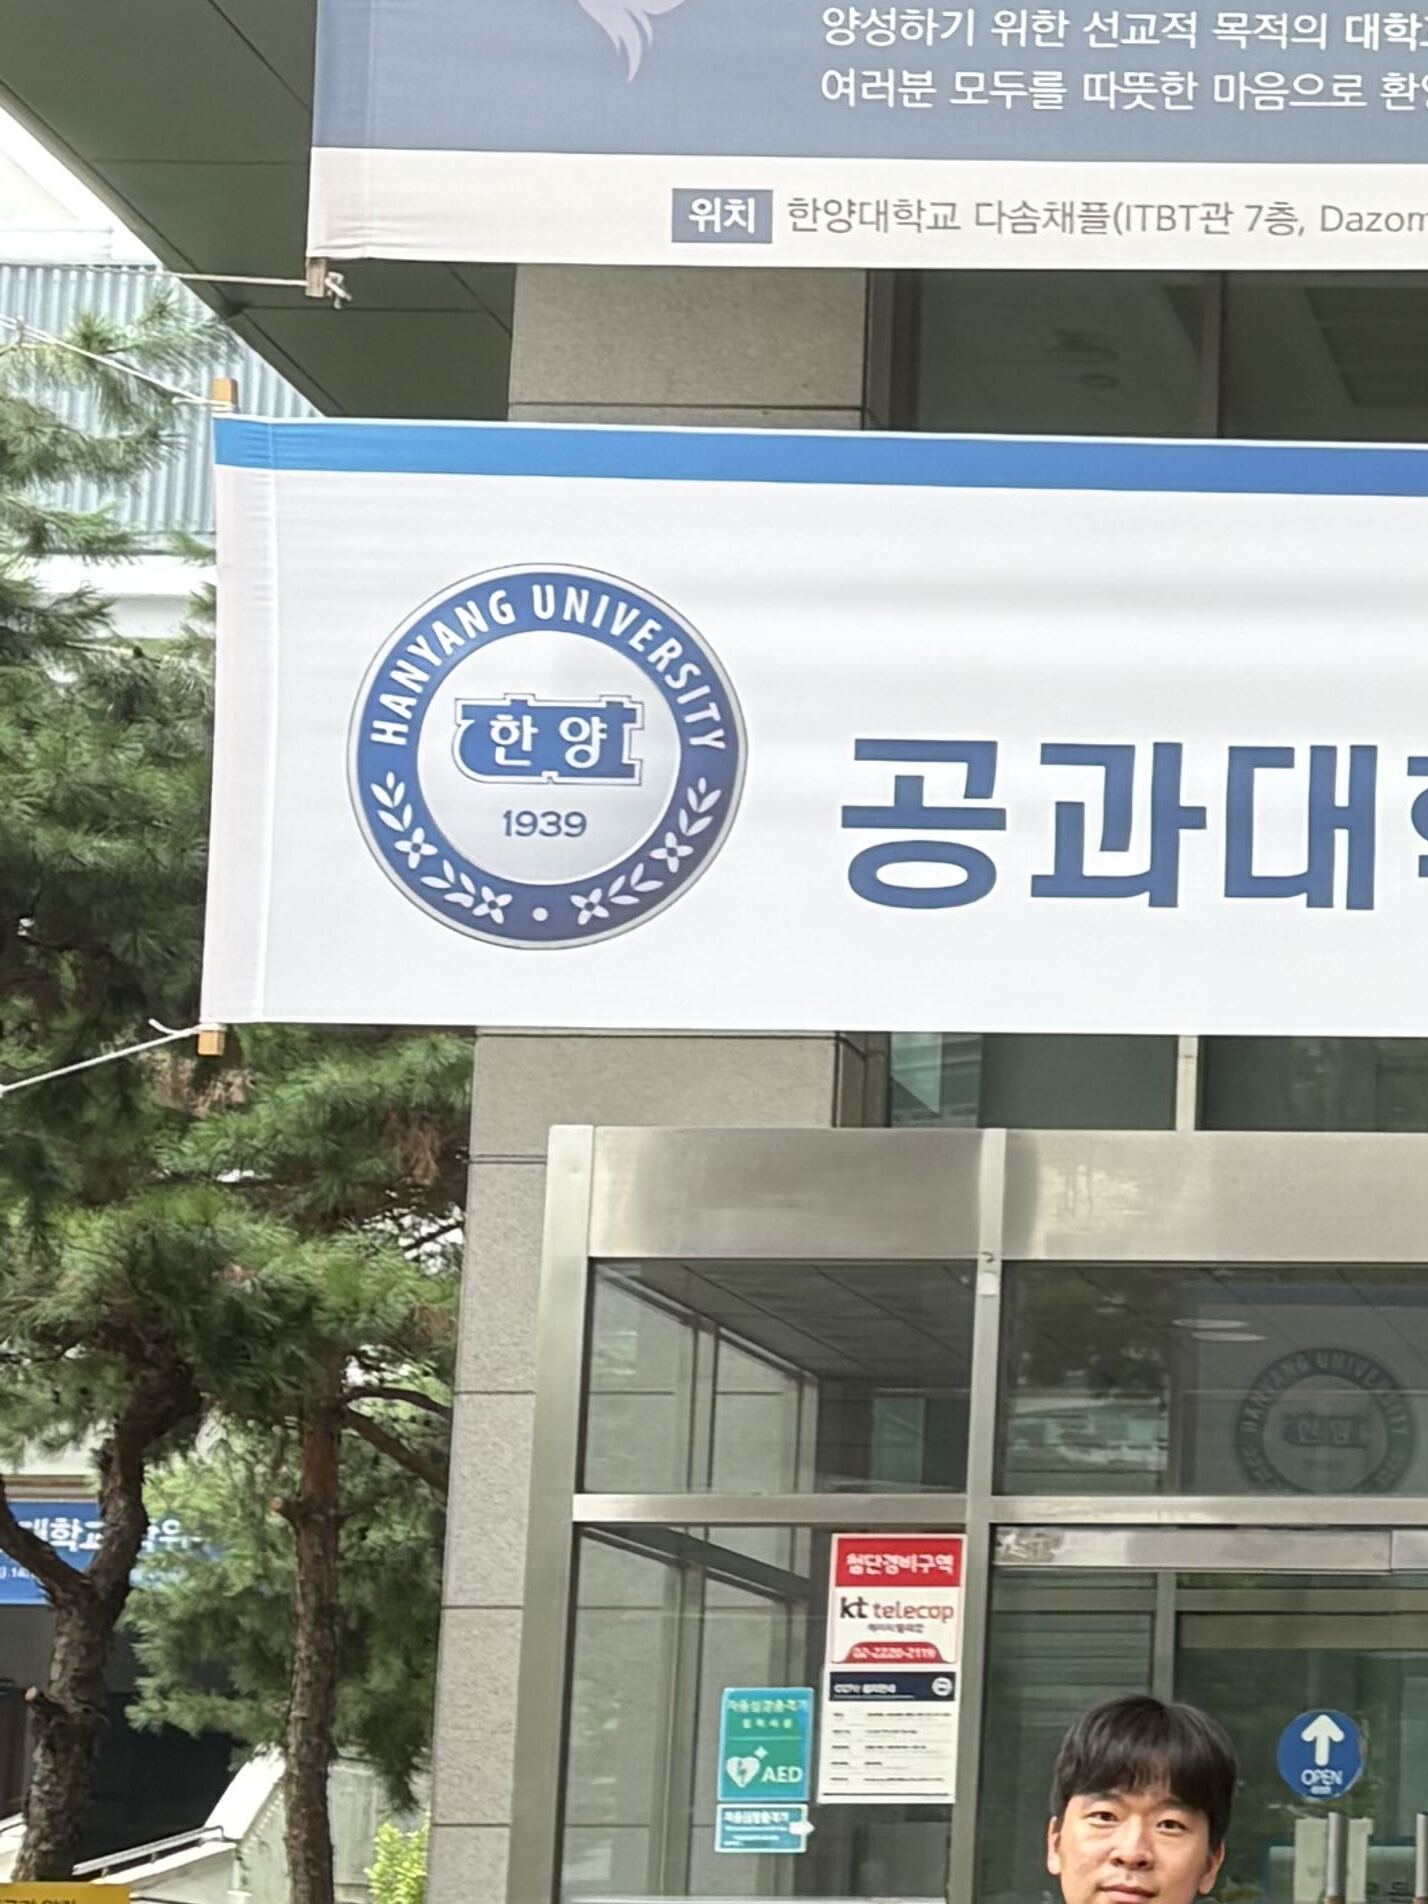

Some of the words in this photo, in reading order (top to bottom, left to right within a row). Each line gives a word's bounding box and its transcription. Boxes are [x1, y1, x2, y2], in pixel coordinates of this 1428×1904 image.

[822, 6, 975, 47] 양성하기
[990, 9, 1071, 48] 위한
[1082, 10, 1197, 49] 선교적
[1212, 12, 1328, 51] 목적의
[821, 67, 937, 108] 여러분
[949, 70, 1068, 110] 모두를
[1083, 70, 1199, 111] 따뜻한
[1213, 71, 1368, 111] 마음으로
[686, 195, 758, 237] 위치
[787, 197, 962, 234] 한양대학교
[974, 199, 1235, 236] 다솜채플(ITBT관
[1244, 201, 1305, 237] 7층,
[372, 585, 523, 752] HANYANG
[528, 580, 725, 754] UNIVERSITY
[487, 711, 611, 767] 한양
[502, 809, 587, 838] 1939
[840, 1596, 868, 1619] kt
[872, 1600, 954, 1623] telecop
[762, 1766, 803, 1783] AED
[1301, 1769, 1342, 1786] OPEN
